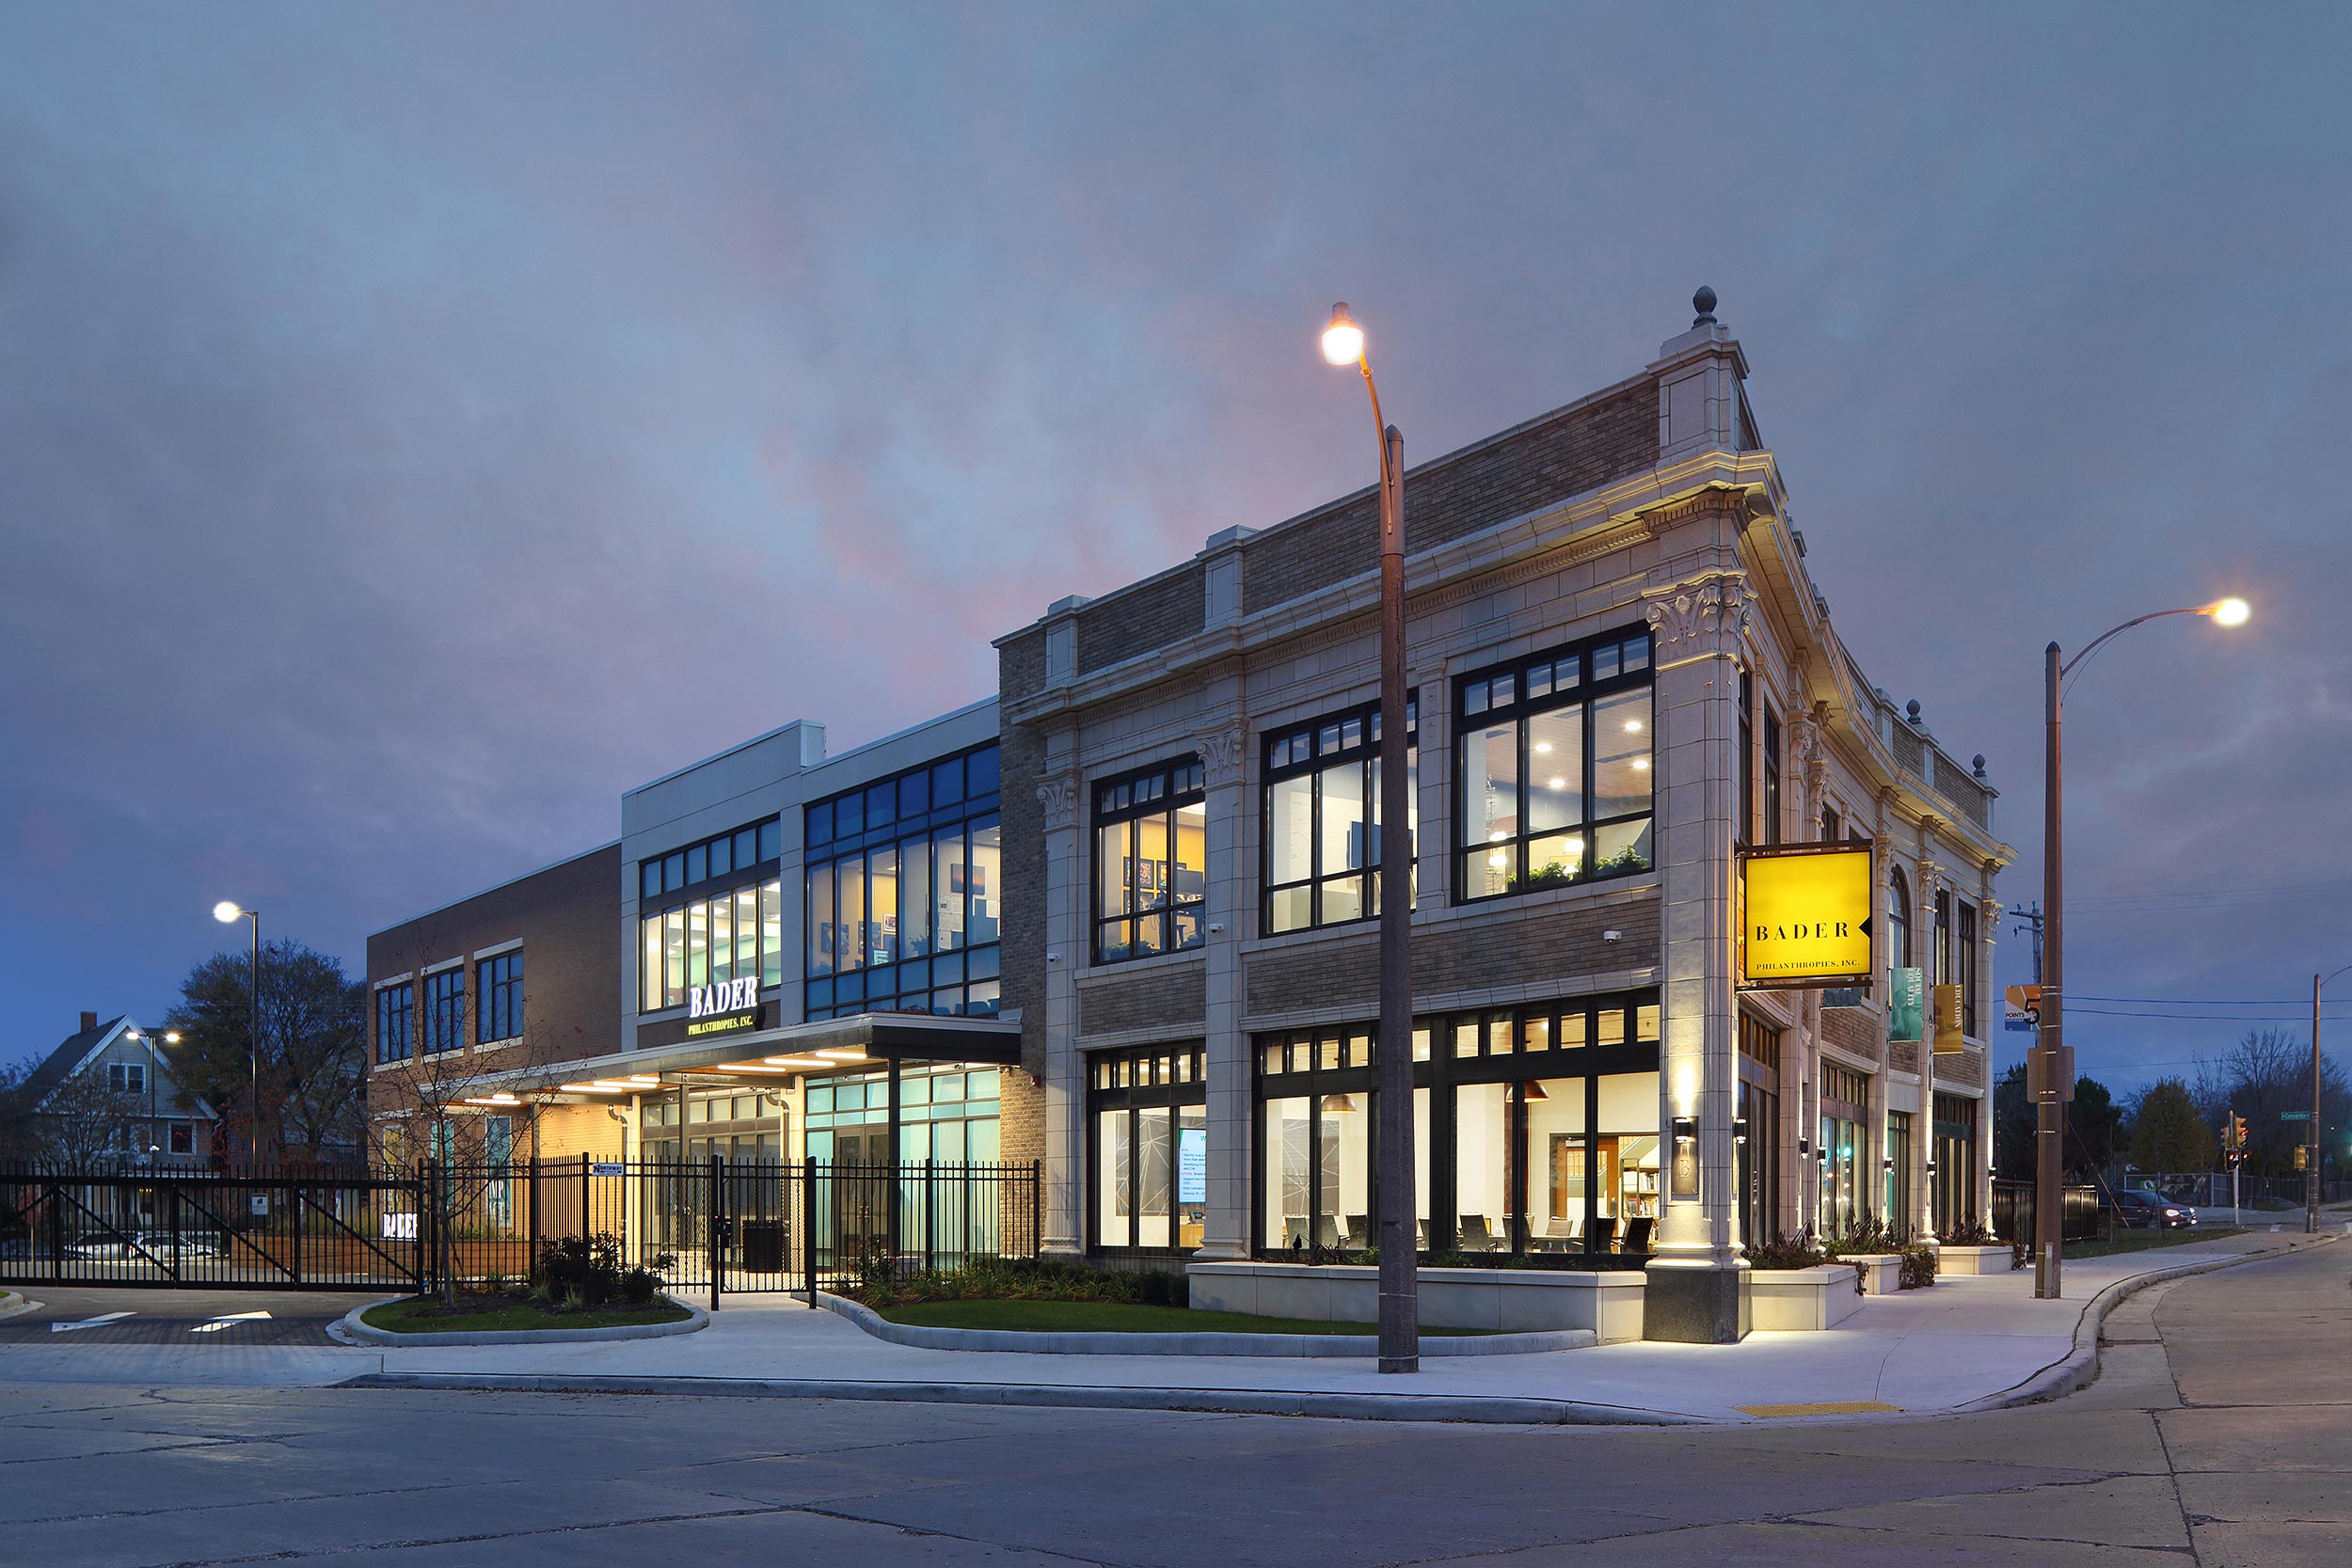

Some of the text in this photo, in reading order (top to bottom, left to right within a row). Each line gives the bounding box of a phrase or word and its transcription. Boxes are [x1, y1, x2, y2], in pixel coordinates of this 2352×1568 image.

[1756, 922, 1849, 942] BADER
[1756, 958, 1860, 971] PHILANTHROPIES, INC.
[690, 975, 758, 1019] BADER
[739, 1015, 754, 1027] INC.
